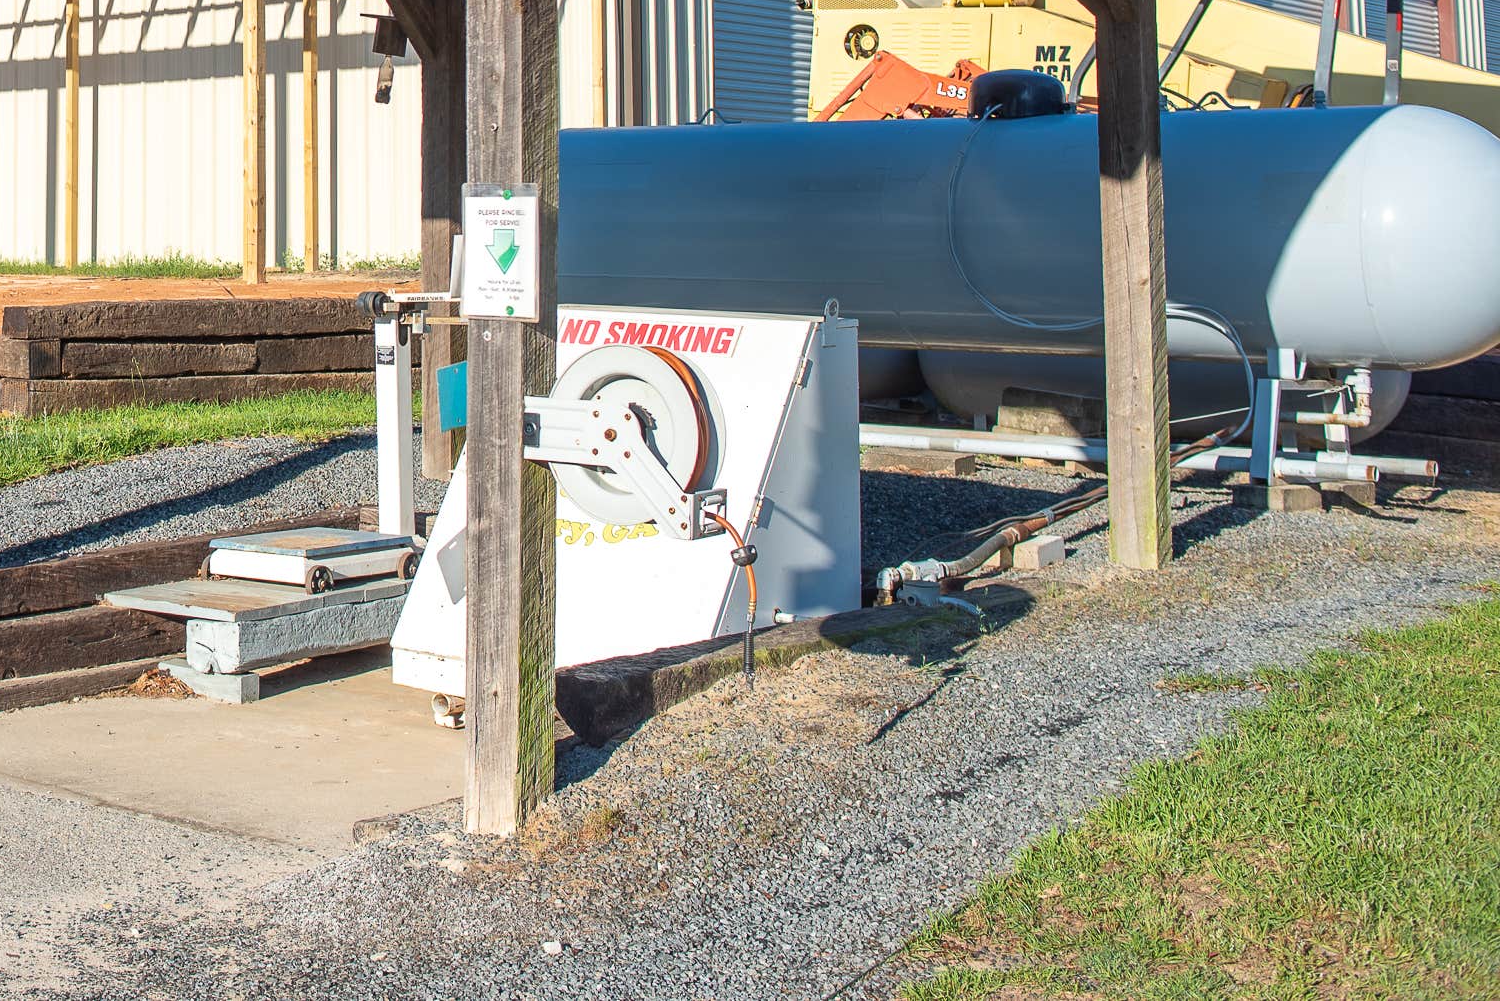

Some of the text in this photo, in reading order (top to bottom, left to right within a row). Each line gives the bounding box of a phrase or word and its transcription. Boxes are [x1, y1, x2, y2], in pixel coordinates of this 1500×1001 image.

[1035, 45, 1071, 62] MZ
[936, 81, 967, 100] L35
[560, 318, 735, 355] NO SMOKING
[603, 523, 660, 544] GA
